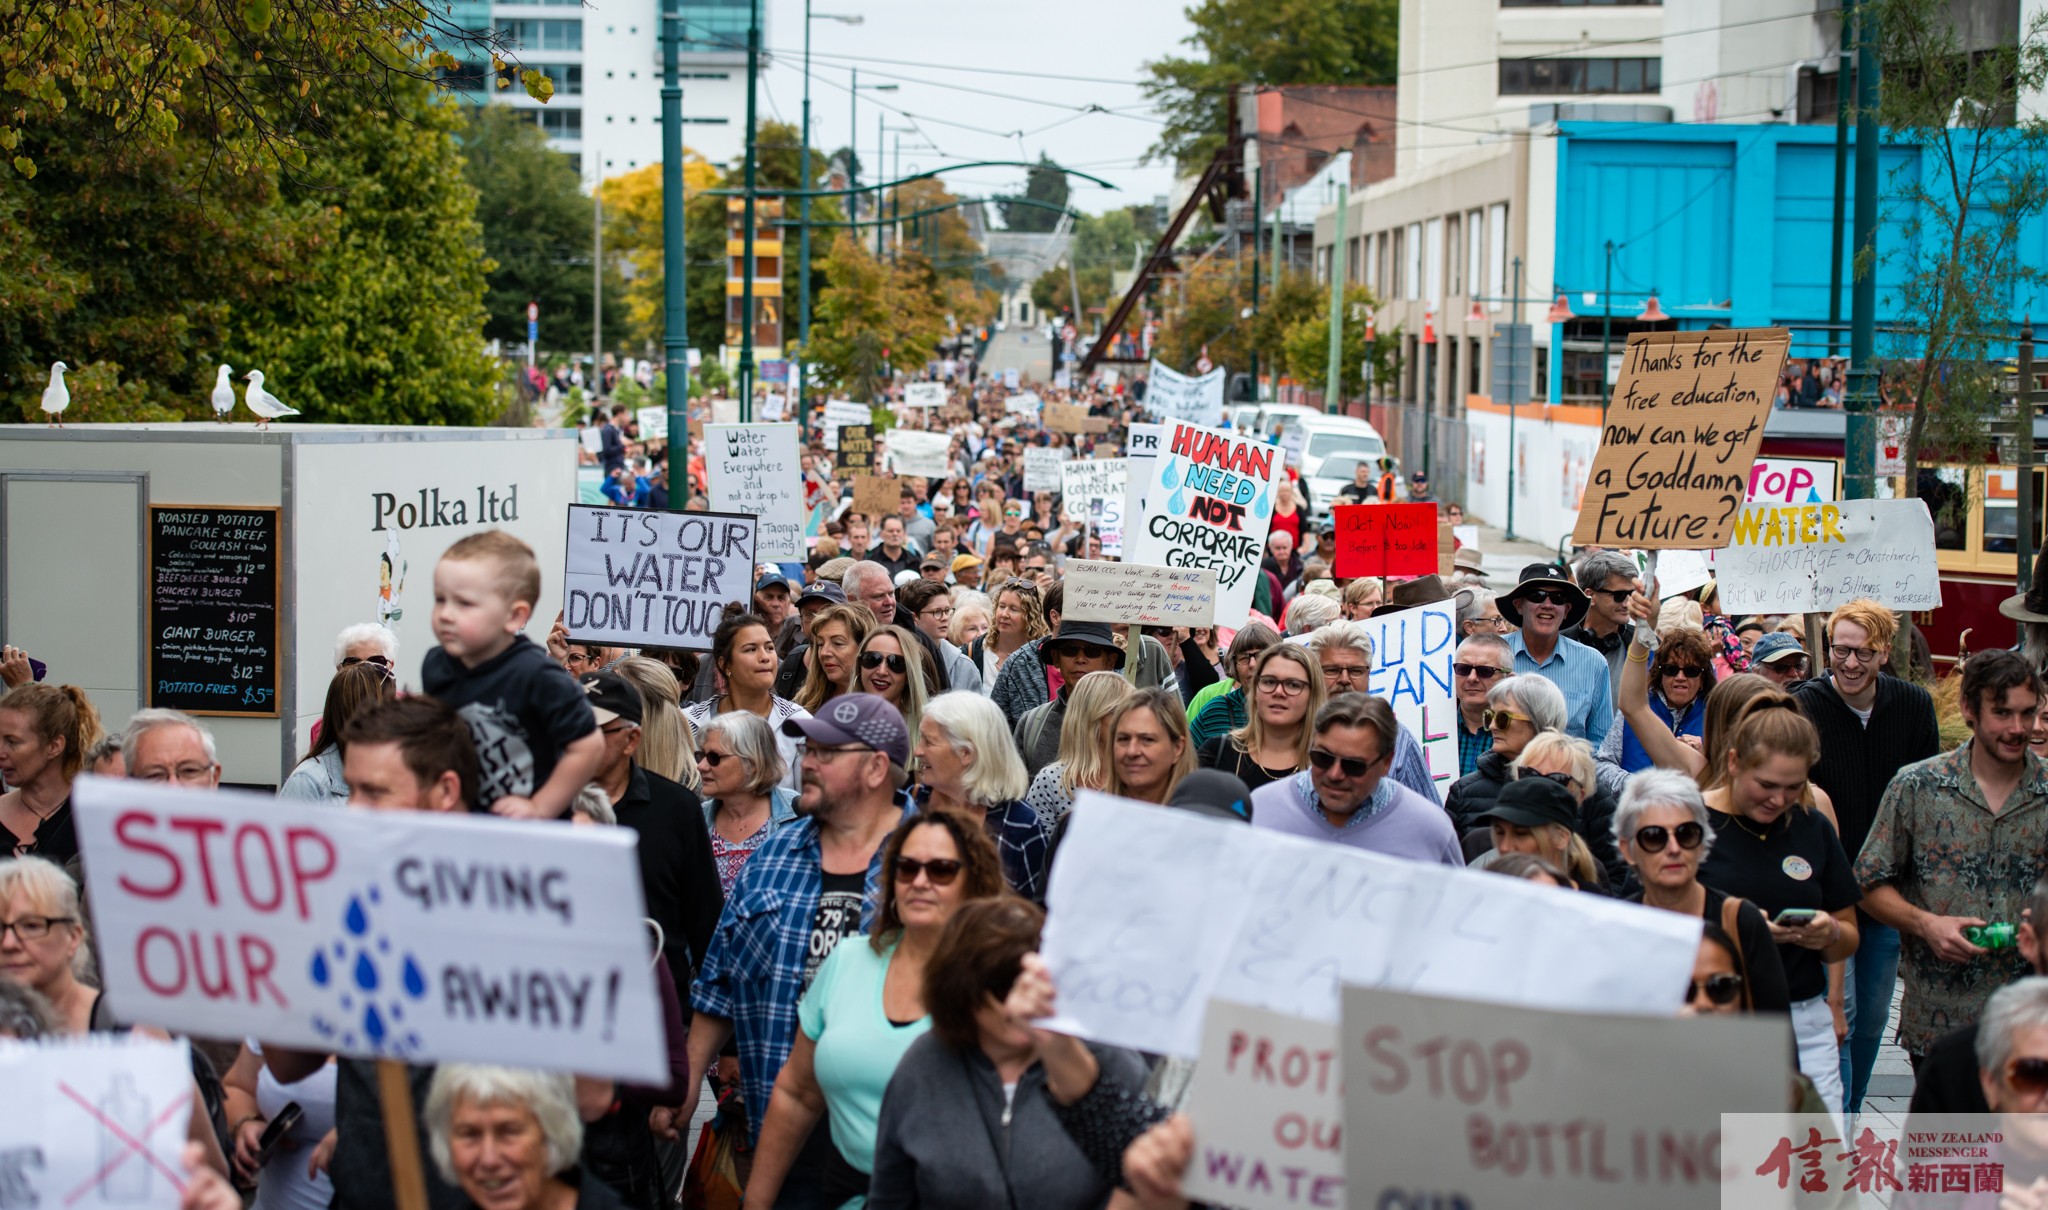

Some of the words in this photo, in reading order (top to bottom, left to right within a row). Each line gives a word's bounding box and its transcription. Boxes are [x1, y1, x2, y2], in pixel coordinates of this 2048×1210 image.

[1631, 335, 1682, 375] Thanks
[1693, 336, 1722, 368] for
[1728, 332, 1763, 364] the
[1624, 380, 1661, 411] free
[1671, 371, 1760, 407] education,
[726, 429, 766, 444] Water
[1132, 434, 1159, 449] PR
[1603, 422, 1646, 446] now
[1650, 426, 1686, 445] can
[1723, 415, 1758, 464] get
[728, 445, 768, 458] Water
[1170, 424, 1274, 482] HUMAN
[724, 458, 783, 480] Everywhere
[744, 475, 762, 490] and
[1595, 468, 1611, 488] a
[1626, 449, 1744, 491] Goddamn
[1747, 463, 1814, 503] TOP
[728, 491, 741, 501] not
[757, 491, 777, 505] drop
[781, 490, 789, 499] to
[1068, 483, 1127, 495] CORPORAT
[1184, 464, 1255, 505] NEED
[158, 512, 209, 524] ROASTED
[217, 514, 263, 527] POTATO
[372, 487, 468, 531] Polka
[477, 483, 519, 523] ltd
[740, 504, 767, 515] Drink
[1188, 496, 1246, 531] NOT
[1595, 491, 1737, 544] Future?
[161, 525, 220, 538] PANCAKE
[234, 529, 267, 540] BEEF
[590, 511, 660, 547] IT'S
[677, 518, 750, 560] OUR
[763, 522, 800, 542] Taonga
[1734, 504, 1846, 546] WATER
[190, 540, 240, 551] GOULASH
[1149, 515, 1261, 566] CORPORATE
[604, 552, 726, 595] WATER
[1151, 569, 1163, 578] for
[1166, 548, 1246, 591] GREED!
[1746, 548, 1843, 575] SHORTAGE
[1855, 548, 1921, 566] Christchurch
[156, 586, 198, 596] CHICKEN
[201, 587, 242, 597] BURGER
[211, 575, 249, 584] BURGER
[1120, 580, 1136, 588] not
[1171, 583, 1190, 591] them
[1727, 582, 1748, 604] But
[1896, 573, 1916, 591] of
[1085, 588, 1099, 597] you
[1103, 589, 1122, 599] give
[1127, 590, 1145, 601] away
[1188, 604, 1202, 613] but
[568, 589, 656, 633] DON'T
[663, 594, 748, 638] TOUC
[1120, 611, 1132, 620] for
[1138, 613, 1159, 621] them
[162, 626, 200, 639] GIANT
[203, 628, 255, 642] BURGER
[158, 680, 203, 693] POTATO
[205, 683, 237, 694] FRIES
[112, 810, 339, 921] STOP
[394, 857, 574, 926] GIVING
[821, 910, 842, 928] 79
[135, 925, 289, 1010] OUR
[442, 961, 623, 1043] AWAY!
[1226, 1029, 1343, 1096] PROT
[1363, 1023, 1531, 1109] STOP
[1273, 1111, 1342, 1153] OU
[1205, 1147, 1345, 1207] WATE
